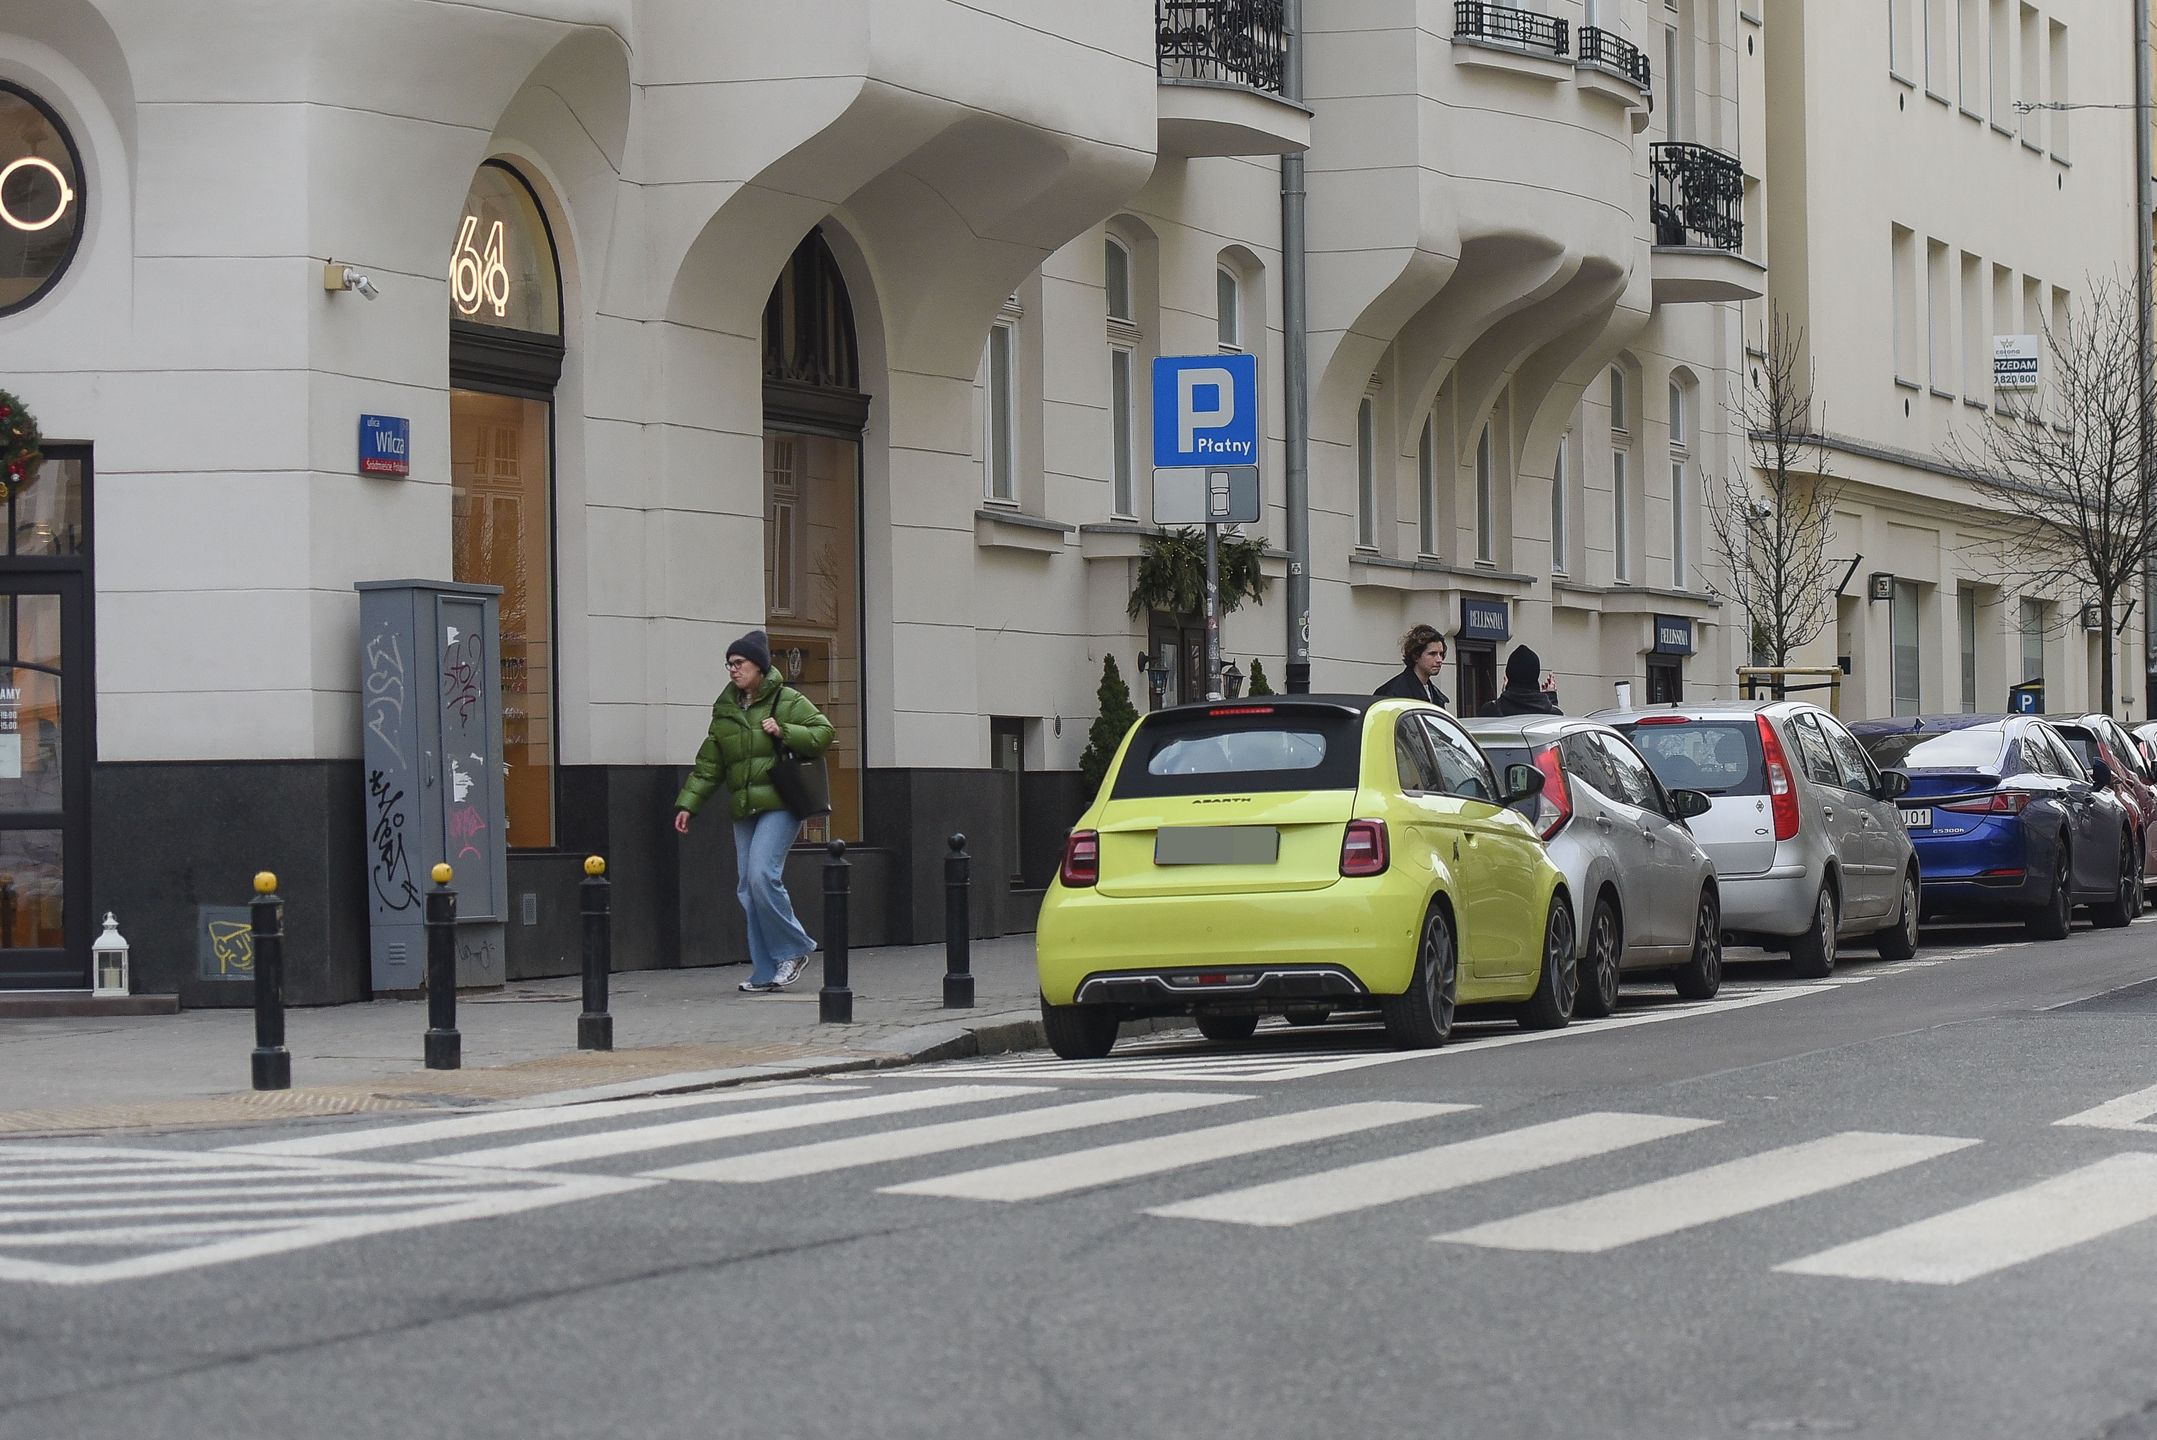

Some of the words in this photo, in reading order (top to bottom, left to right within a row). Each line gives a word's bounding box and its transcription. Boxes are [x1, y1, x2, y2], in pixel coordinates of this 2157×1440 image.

[2000, 375, 2017, 384] 820
[2019, 374, 2037, 384] 800
[1177, 367, 1235, 453] P
[375, 430, 405, 455] Wilcza
[1198, 438, 1251, 456] Płatny
[2021, 694, 2033, 712] P
